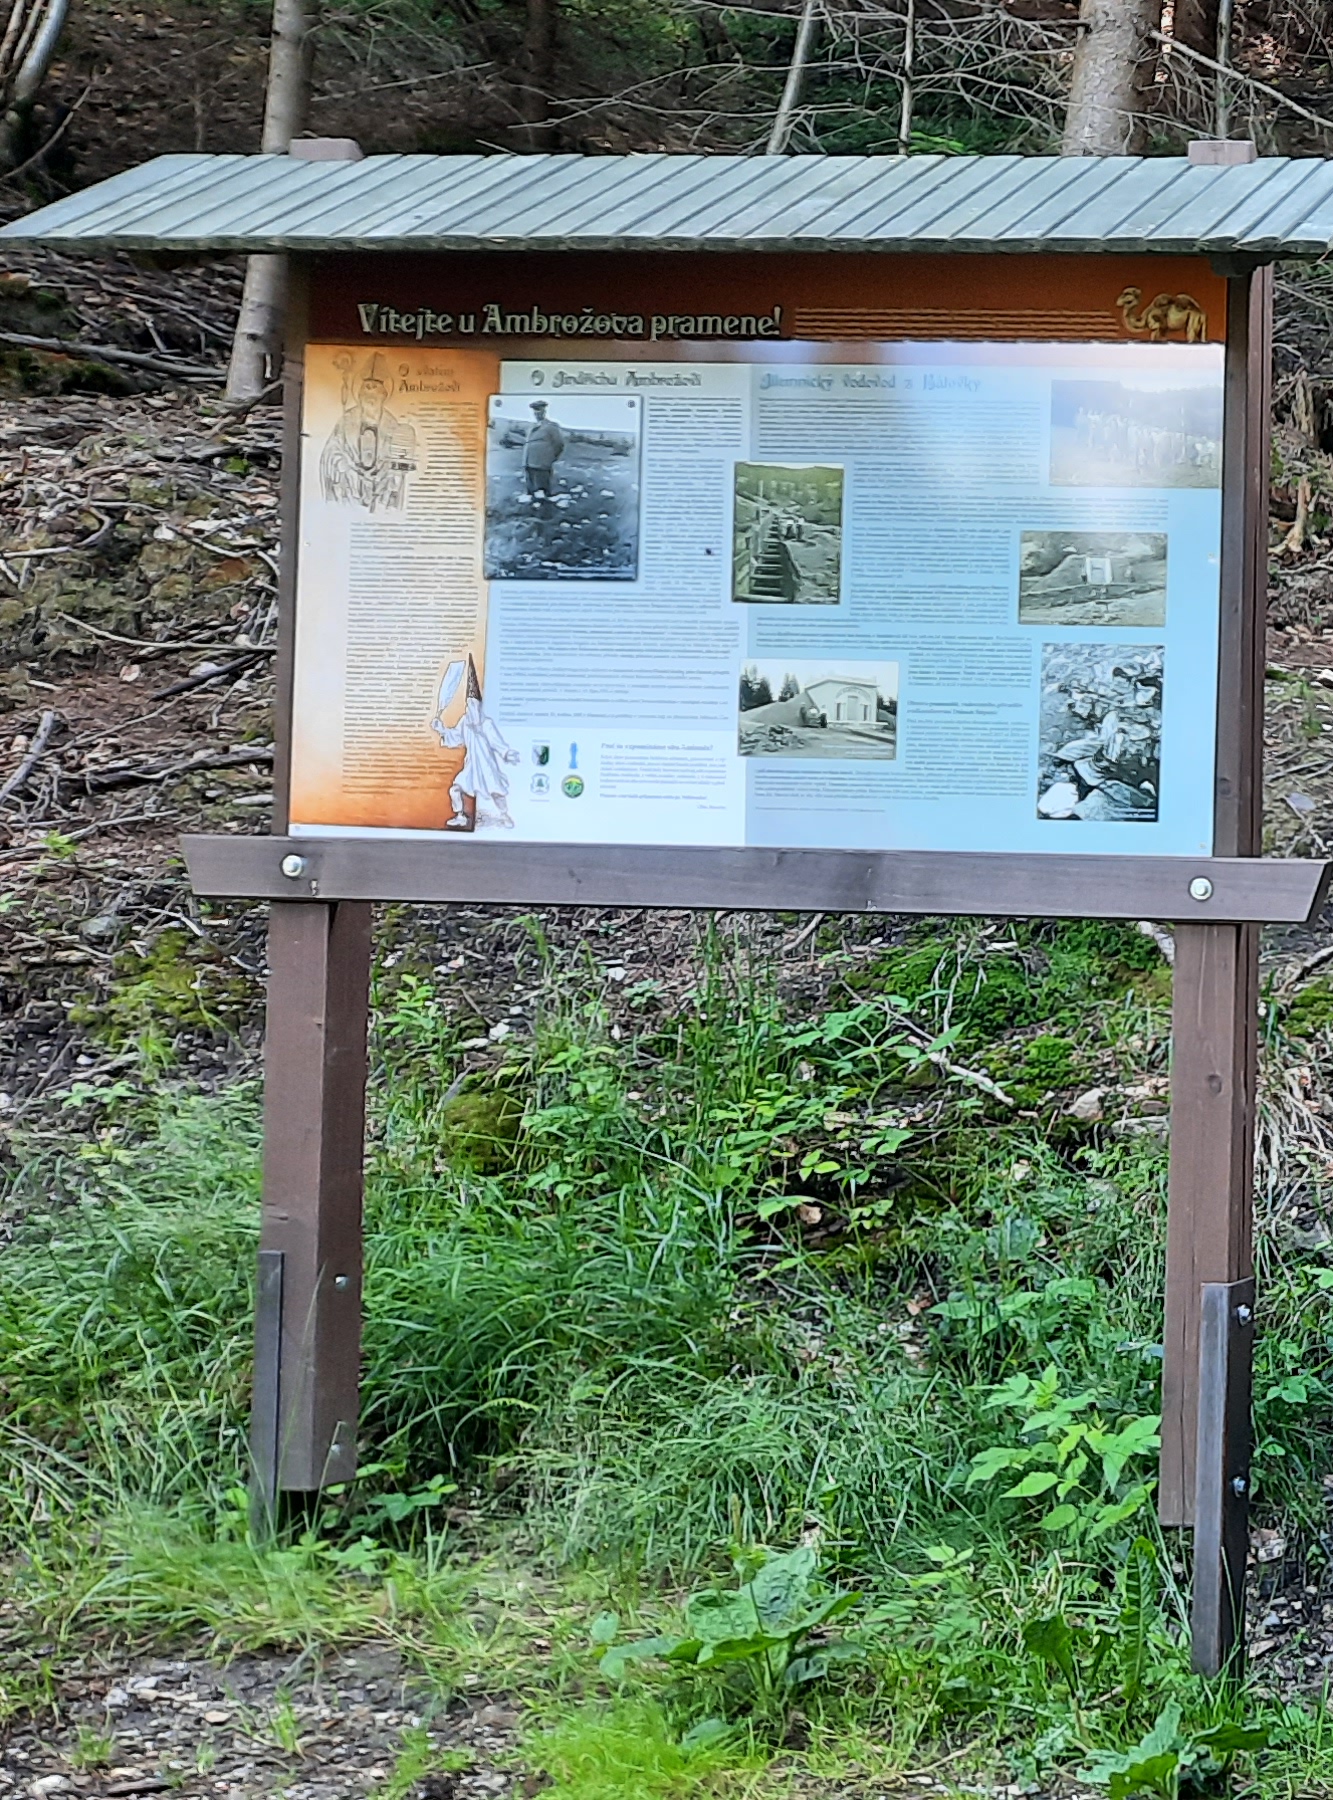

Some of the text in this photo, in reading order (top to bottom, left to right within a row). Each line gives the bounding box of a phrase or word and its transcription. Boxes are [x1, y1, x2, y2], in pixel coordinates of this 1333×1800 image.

[357, 303, 781, 341] Vítejte u Ambrožova pramene!
